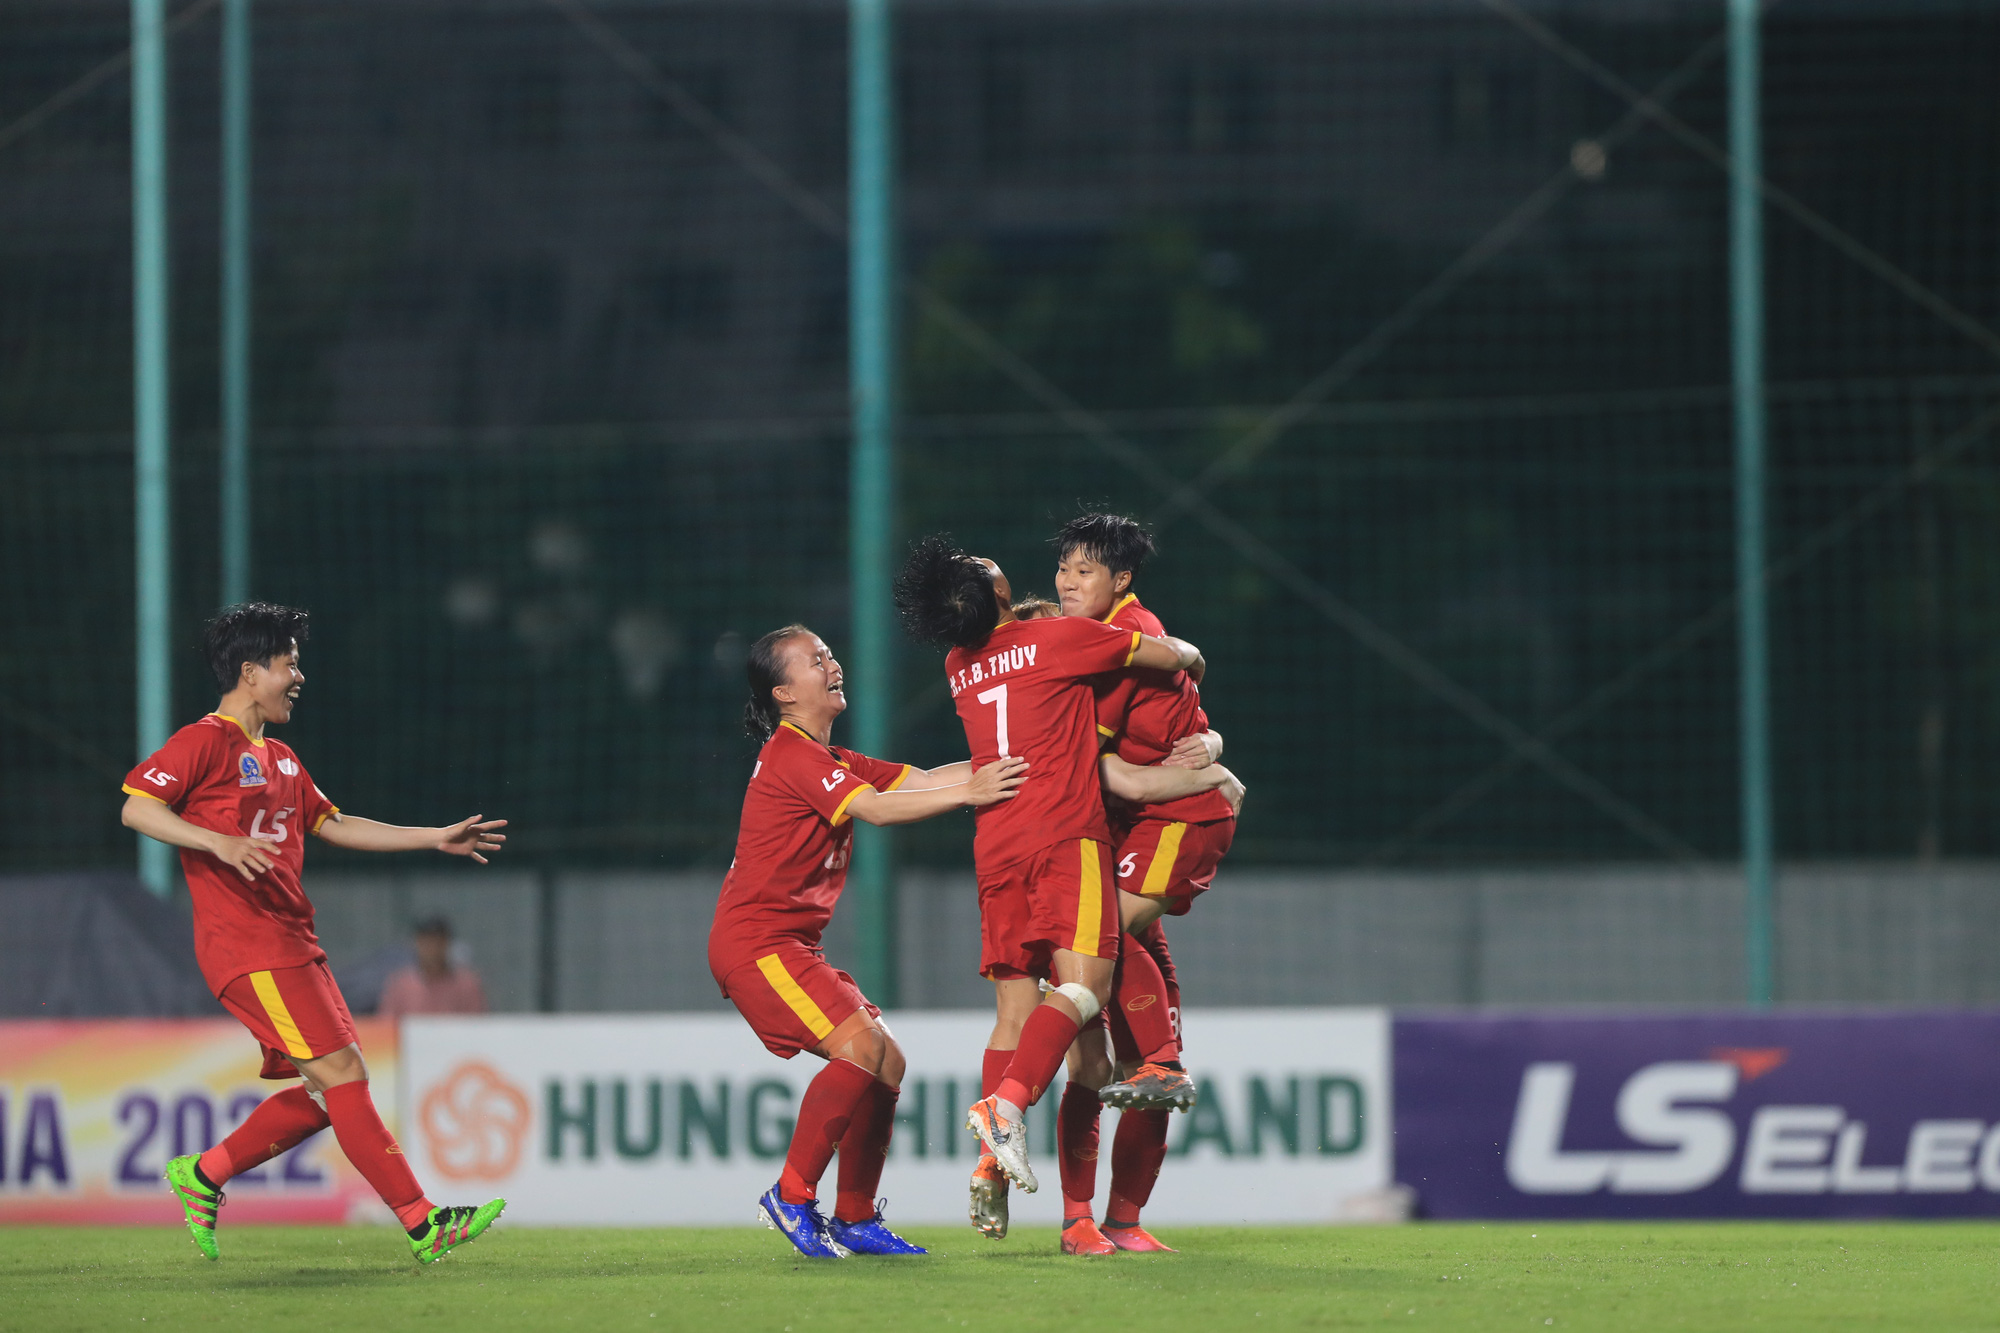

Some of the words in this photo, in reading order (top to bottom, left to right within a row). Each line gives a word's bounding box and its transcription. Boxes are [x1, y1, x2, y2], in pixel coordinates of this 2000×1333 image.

[977, 683, 1010, 760] 7
[143, 767, 171, 787] LS
[821, 769, 846, 792] LS
[250, 808, 289, 843] LS
[545, 1078, 798, 1161] HUNG
[1163, 1074, 1365, 1160] AND
